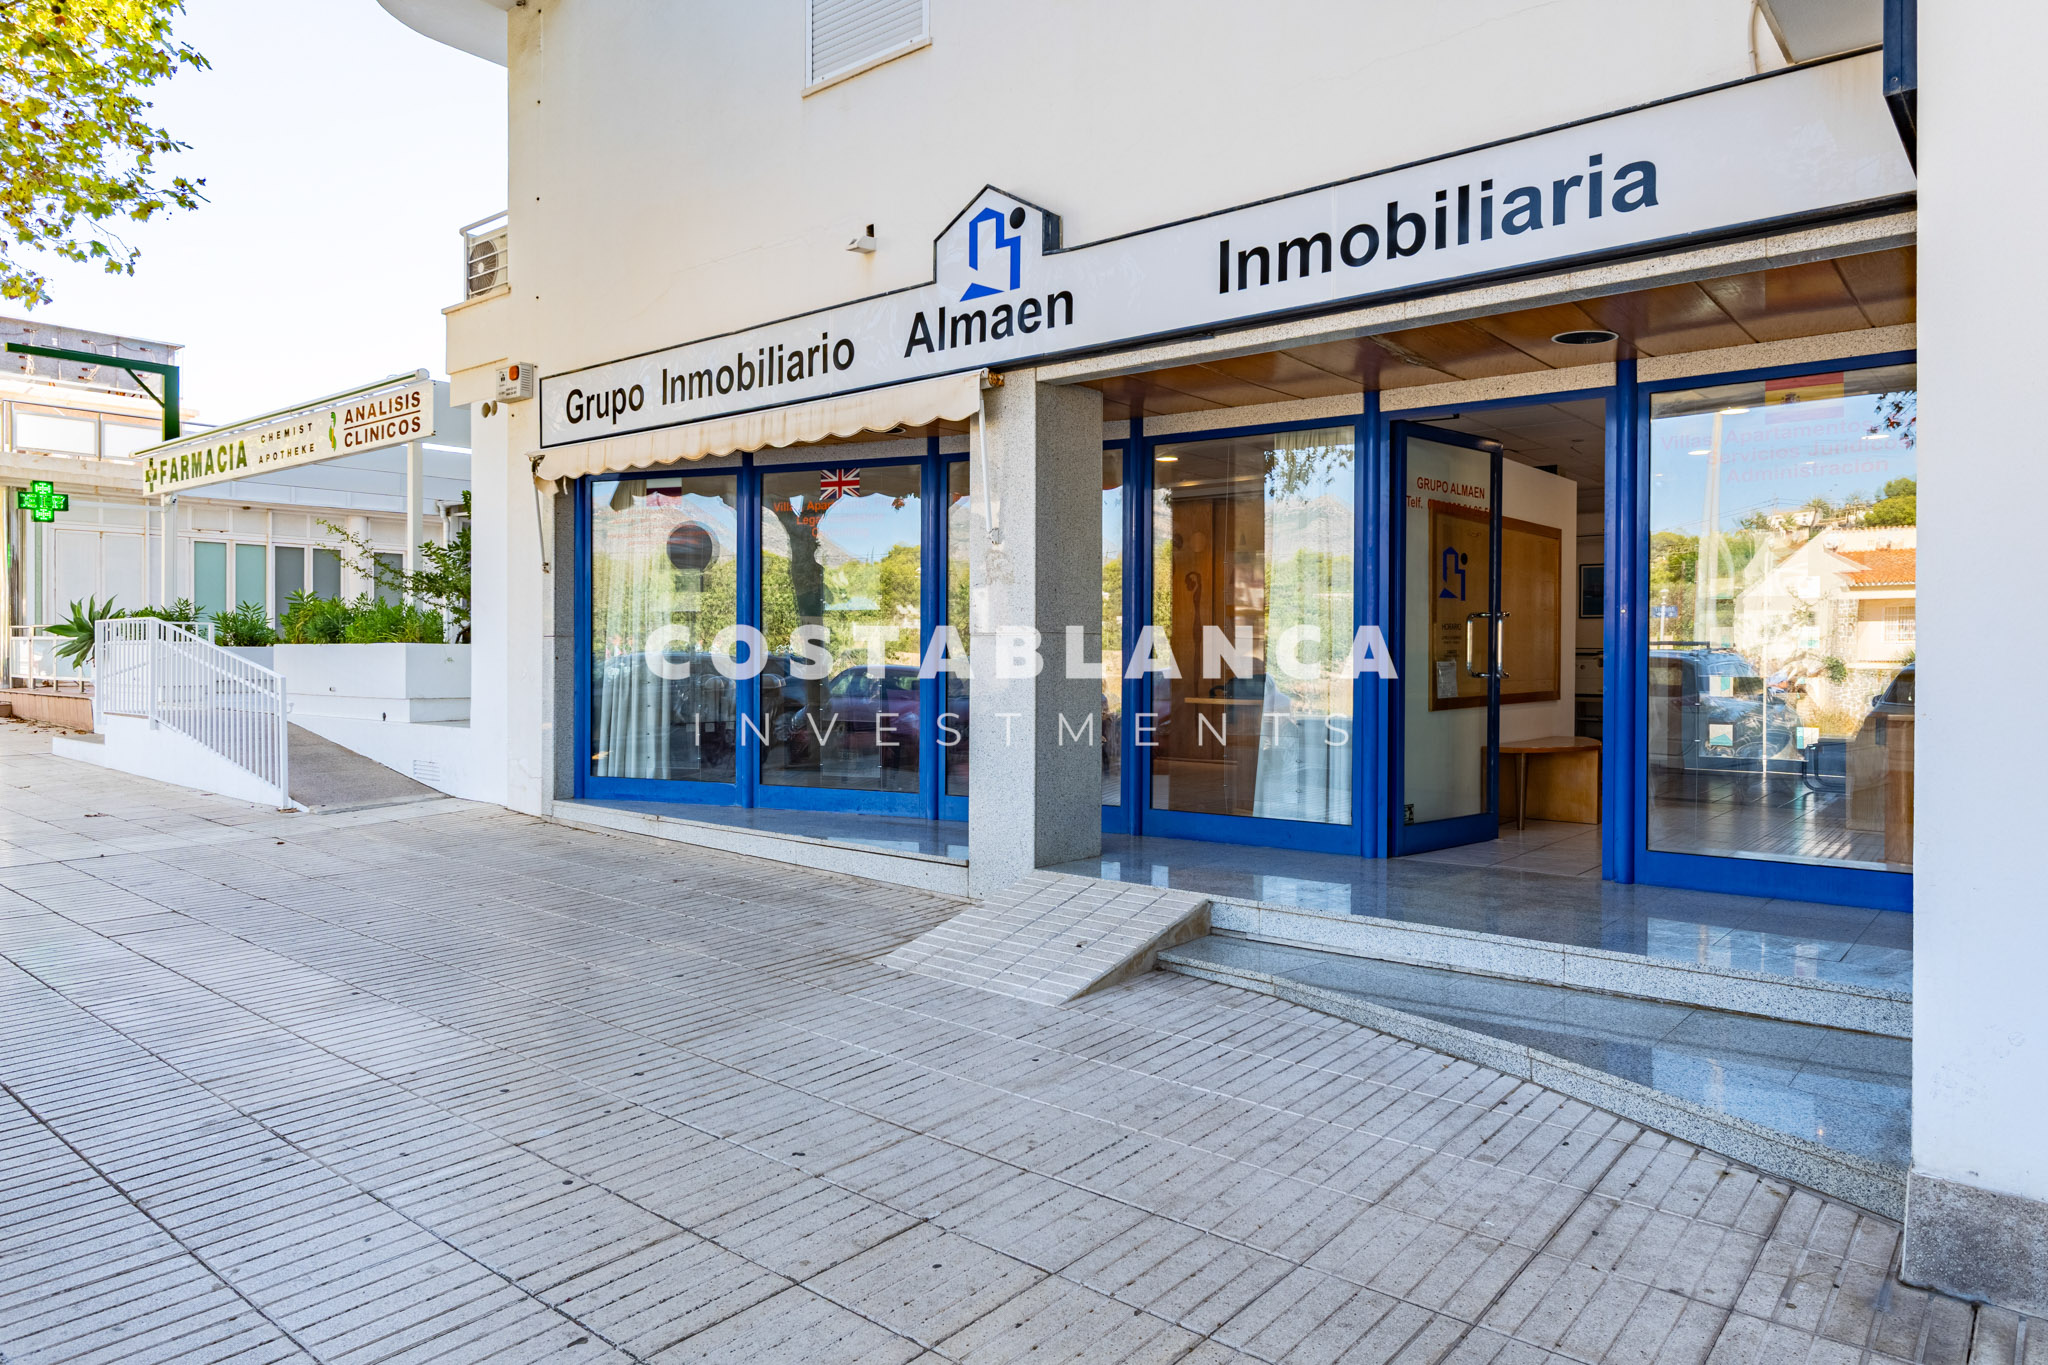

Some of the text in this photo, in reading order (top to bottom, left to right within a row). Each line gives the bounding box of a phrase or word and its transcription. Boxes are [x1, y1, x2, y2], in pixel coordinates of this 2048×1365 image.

[1219, 152, 1659, 294] Inmobiliaria
[904, 290, 1073, 358] Almaen
[565, 332, 855, 425] Grupo Inmobiliario
[344, 391, 421, 425] ANALISIS
[260, 422, 313, 443] CHEMIST
[344, 415, 421, 447] CLINICOS
[160, 440, 248, 485] FARMACIA
[259, 443, 315, 464] APOTHEKE
[1406, 495, 1423, 509] Telf.
[1416, 476, 1485, 499] GRUPO ALMAEN
